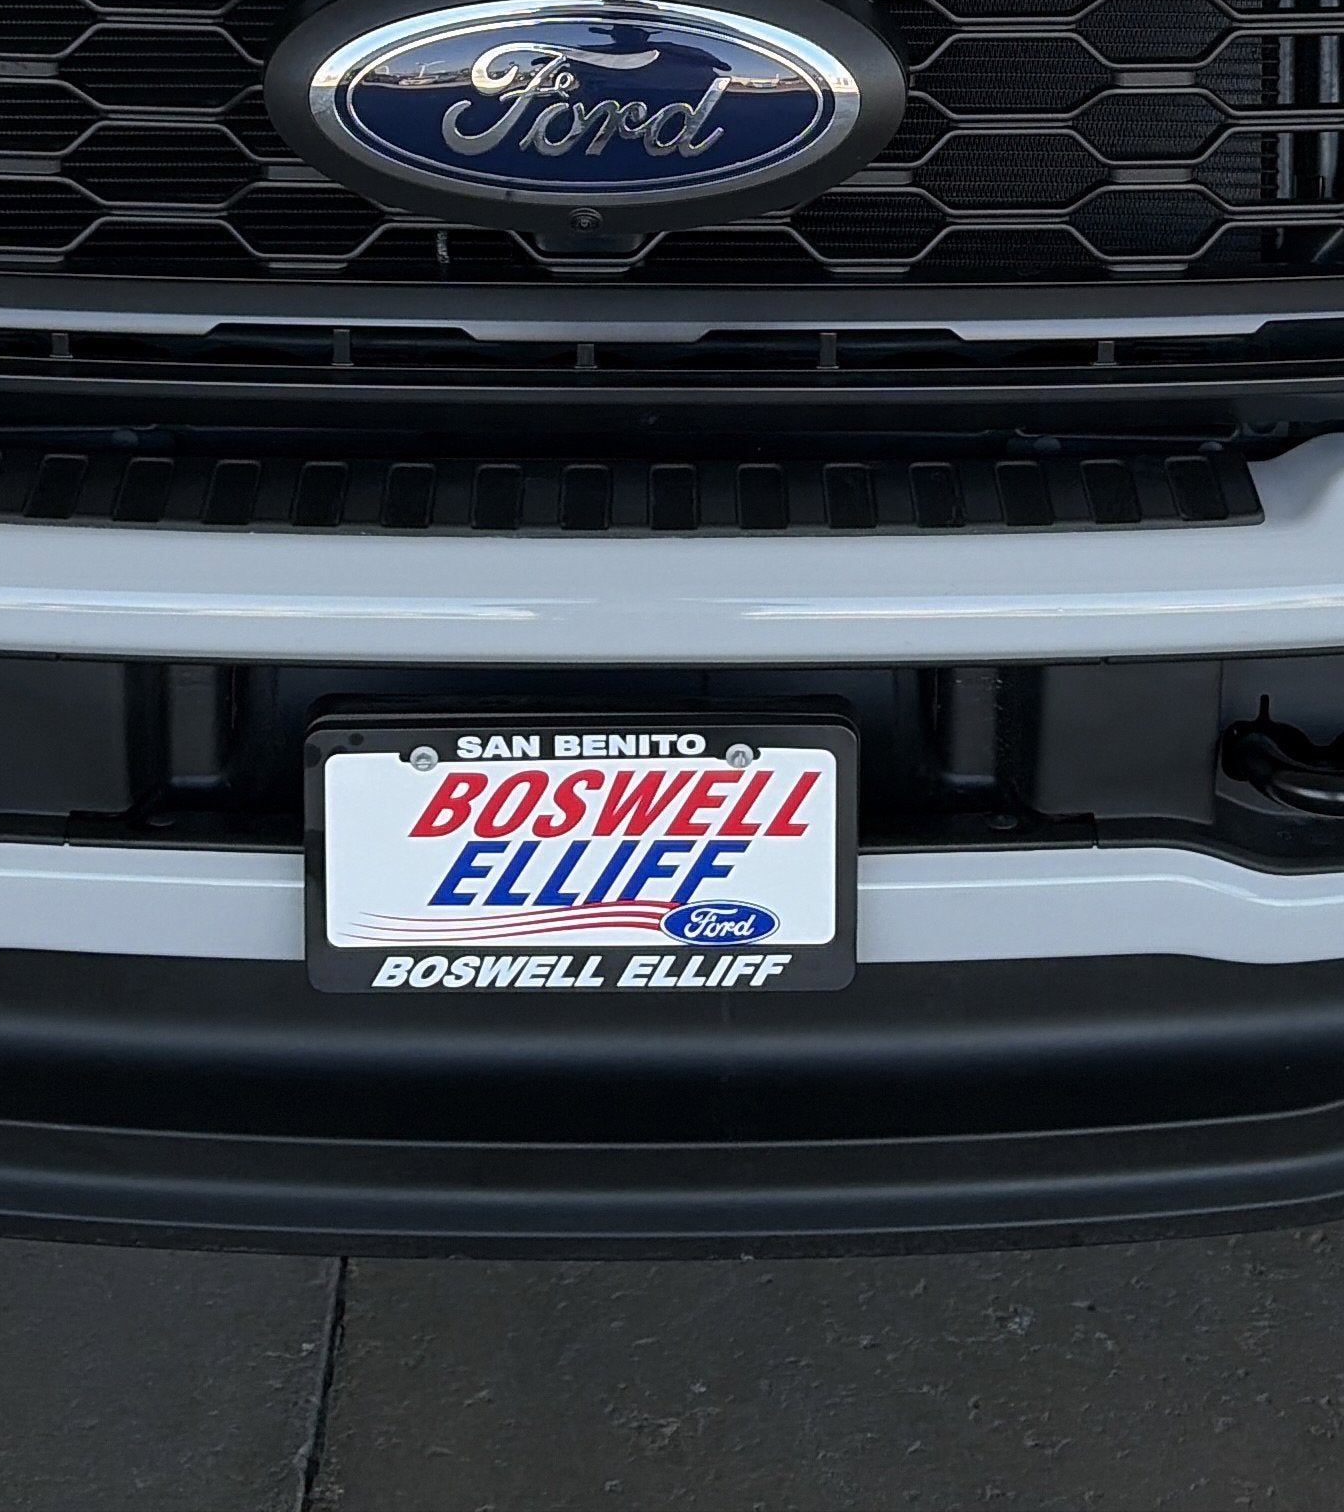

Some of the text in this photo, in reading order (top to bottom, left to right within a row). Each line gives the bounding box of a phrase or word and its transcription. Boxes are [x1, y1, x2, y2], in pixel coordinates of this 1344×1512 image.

[441, 41, 731, 158] Ford
[456, 734, 706, 760] SAN BENITO
[407, 770, 822, 838] BOSWELL
[427, 839, 752, 906] ELLIFF
[683, 909, 757, 939] Ford
[371, 955, 792, 988] BOSWELL ELLIFF
